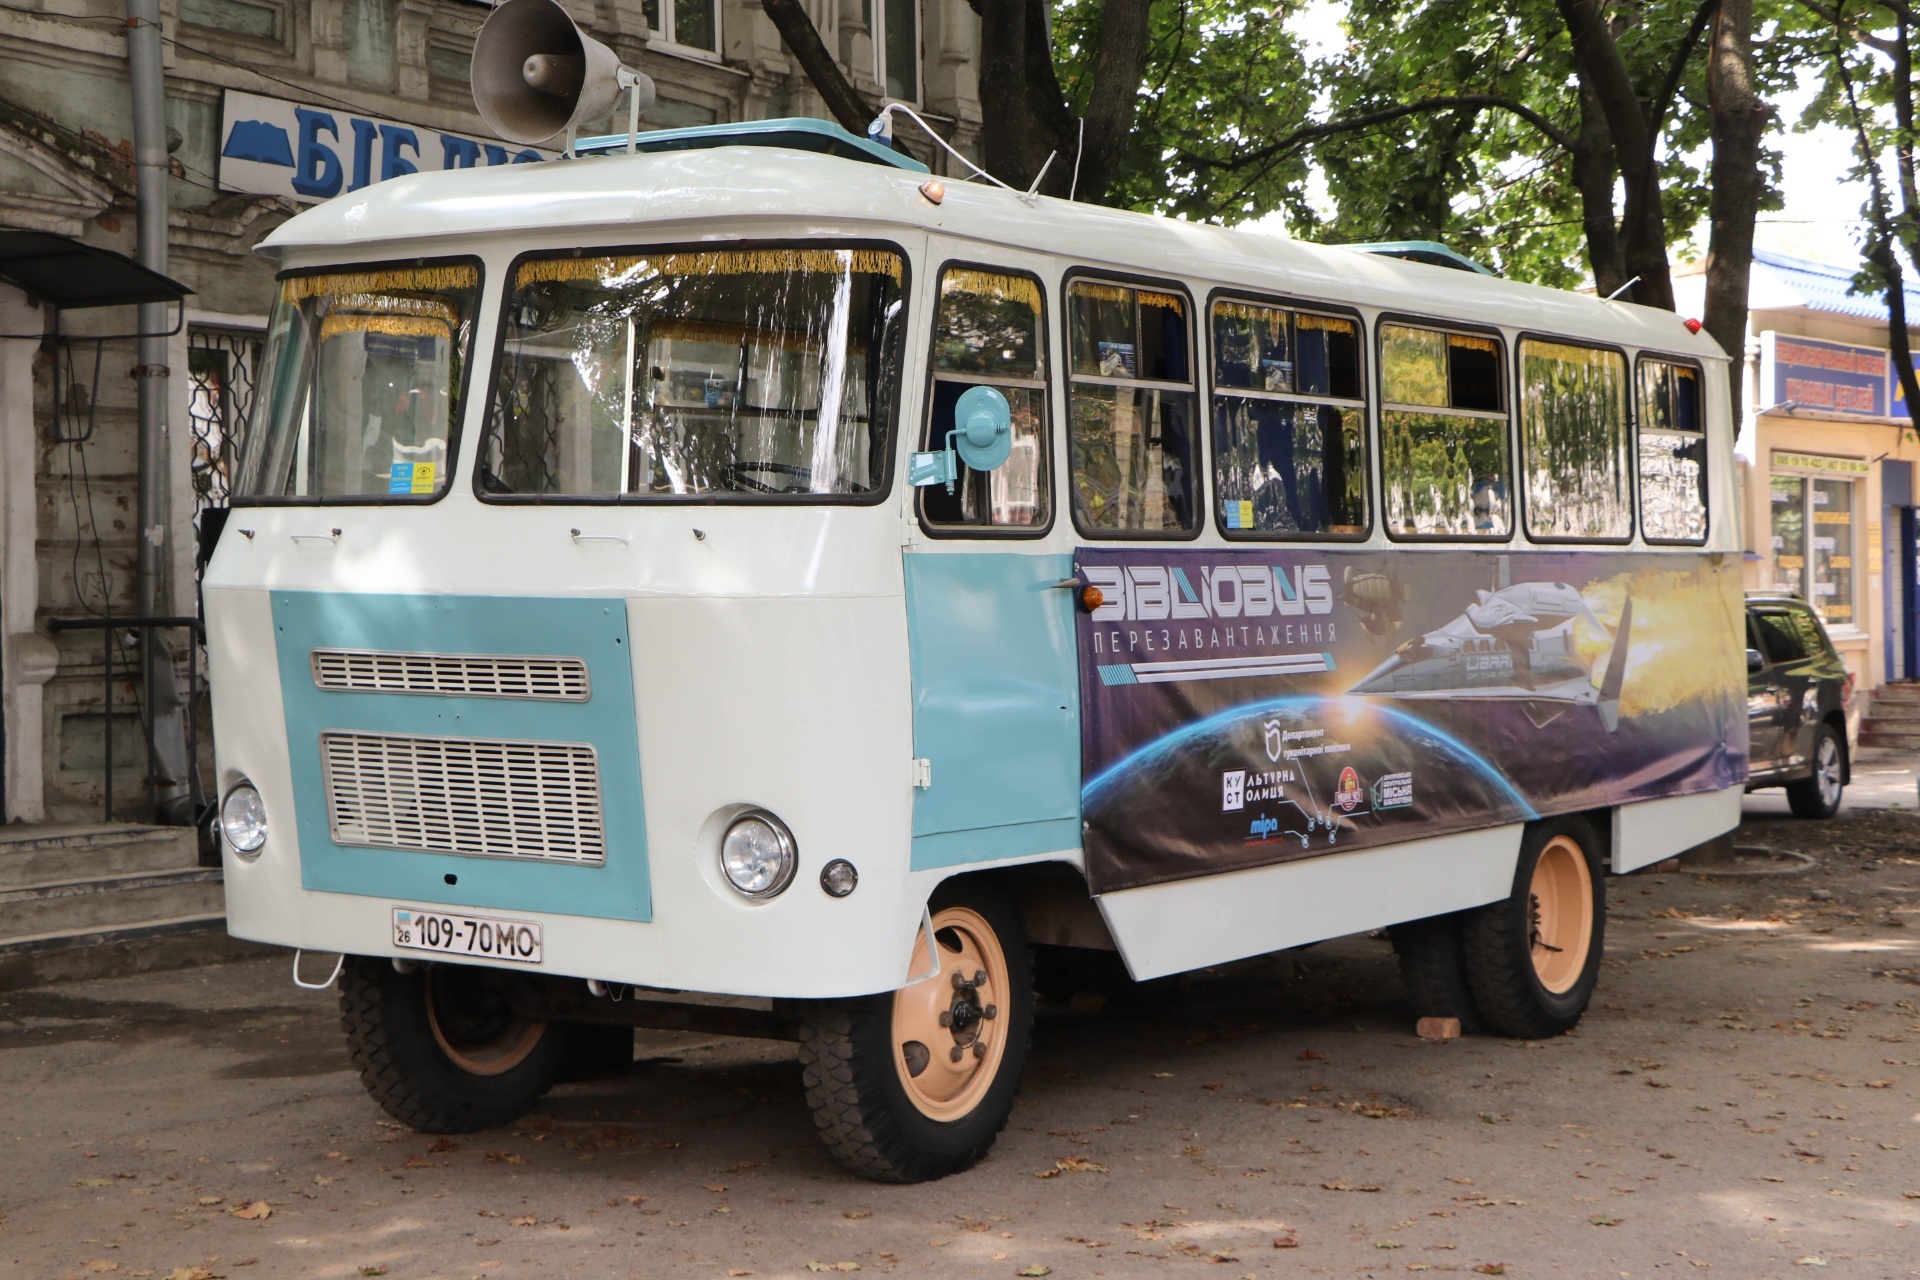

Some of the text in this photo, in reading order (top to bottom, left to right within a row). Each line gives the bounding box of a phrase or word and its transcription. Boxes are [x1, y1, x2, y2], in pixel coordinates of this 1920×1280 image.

[1093, 622, 1337, 654] ПЕРЕЗАВАНТАЖЕННЯ
[1383, 785, 1413, 799] МІСЬКА
[397, 929, 411, 943] 26
